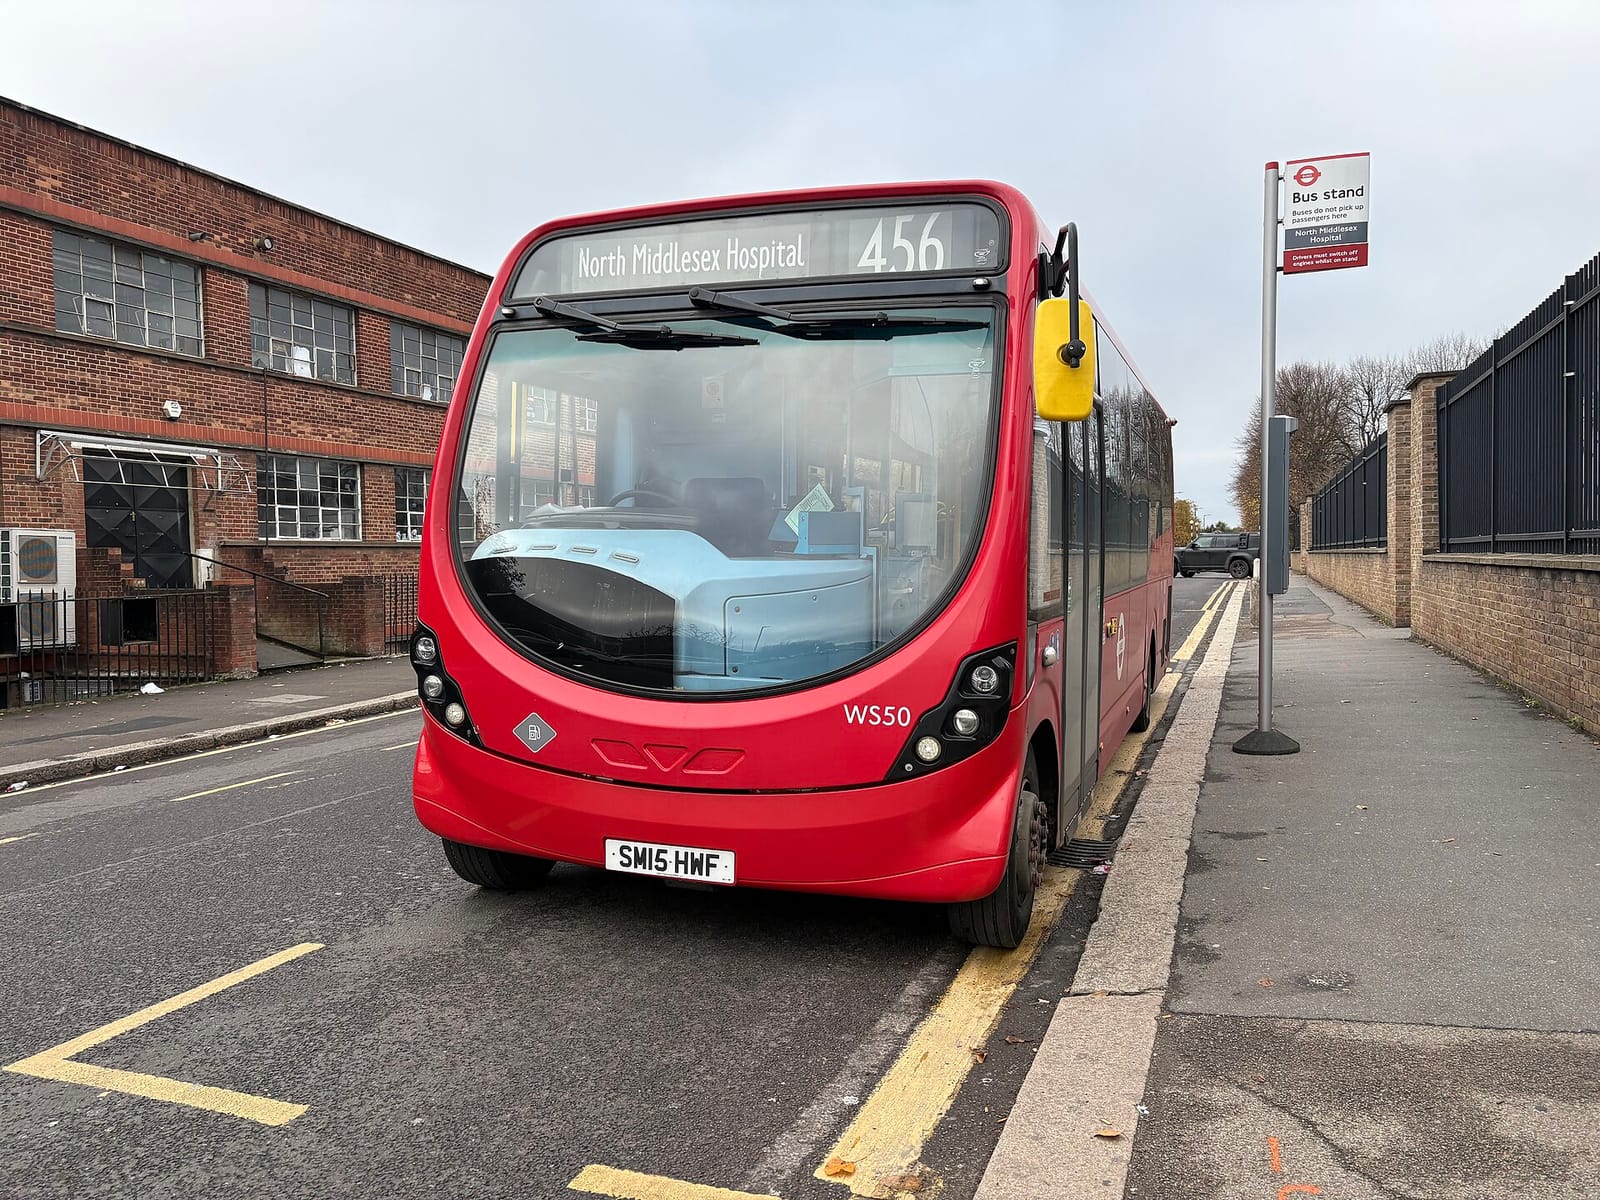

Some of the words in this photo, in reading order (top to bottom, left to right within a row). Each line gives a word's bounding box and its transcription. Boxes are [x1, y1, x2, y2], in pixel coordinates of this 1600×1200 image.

[1292, 191, 1318, 203] Bus
[1323, 185, 1364, 200] stand
[1292, 208, 1312, 216] Buses
[1338, 204, 1353, 214] pick
[1292, 214, 1330, 224] passengers
[1331, 211, 1347, 219] here
[1295, 227, 1318, 237] North
[1319, 225, 1358, 235] Middlesex
[857, 212, 944, 273] 456
[1310, 234, 1342, 244] Hospital
[578, 245, 626, 278] North
[632, 242, 721, 275] Middlesex
[727, 233, 805, 279] Hospital
[1329, 250, 1348, 258] switch
[843, 704, 911, 727] WS50
[619, 845, 668, 872] SM15
[674, 850, 720, 877] HWF
